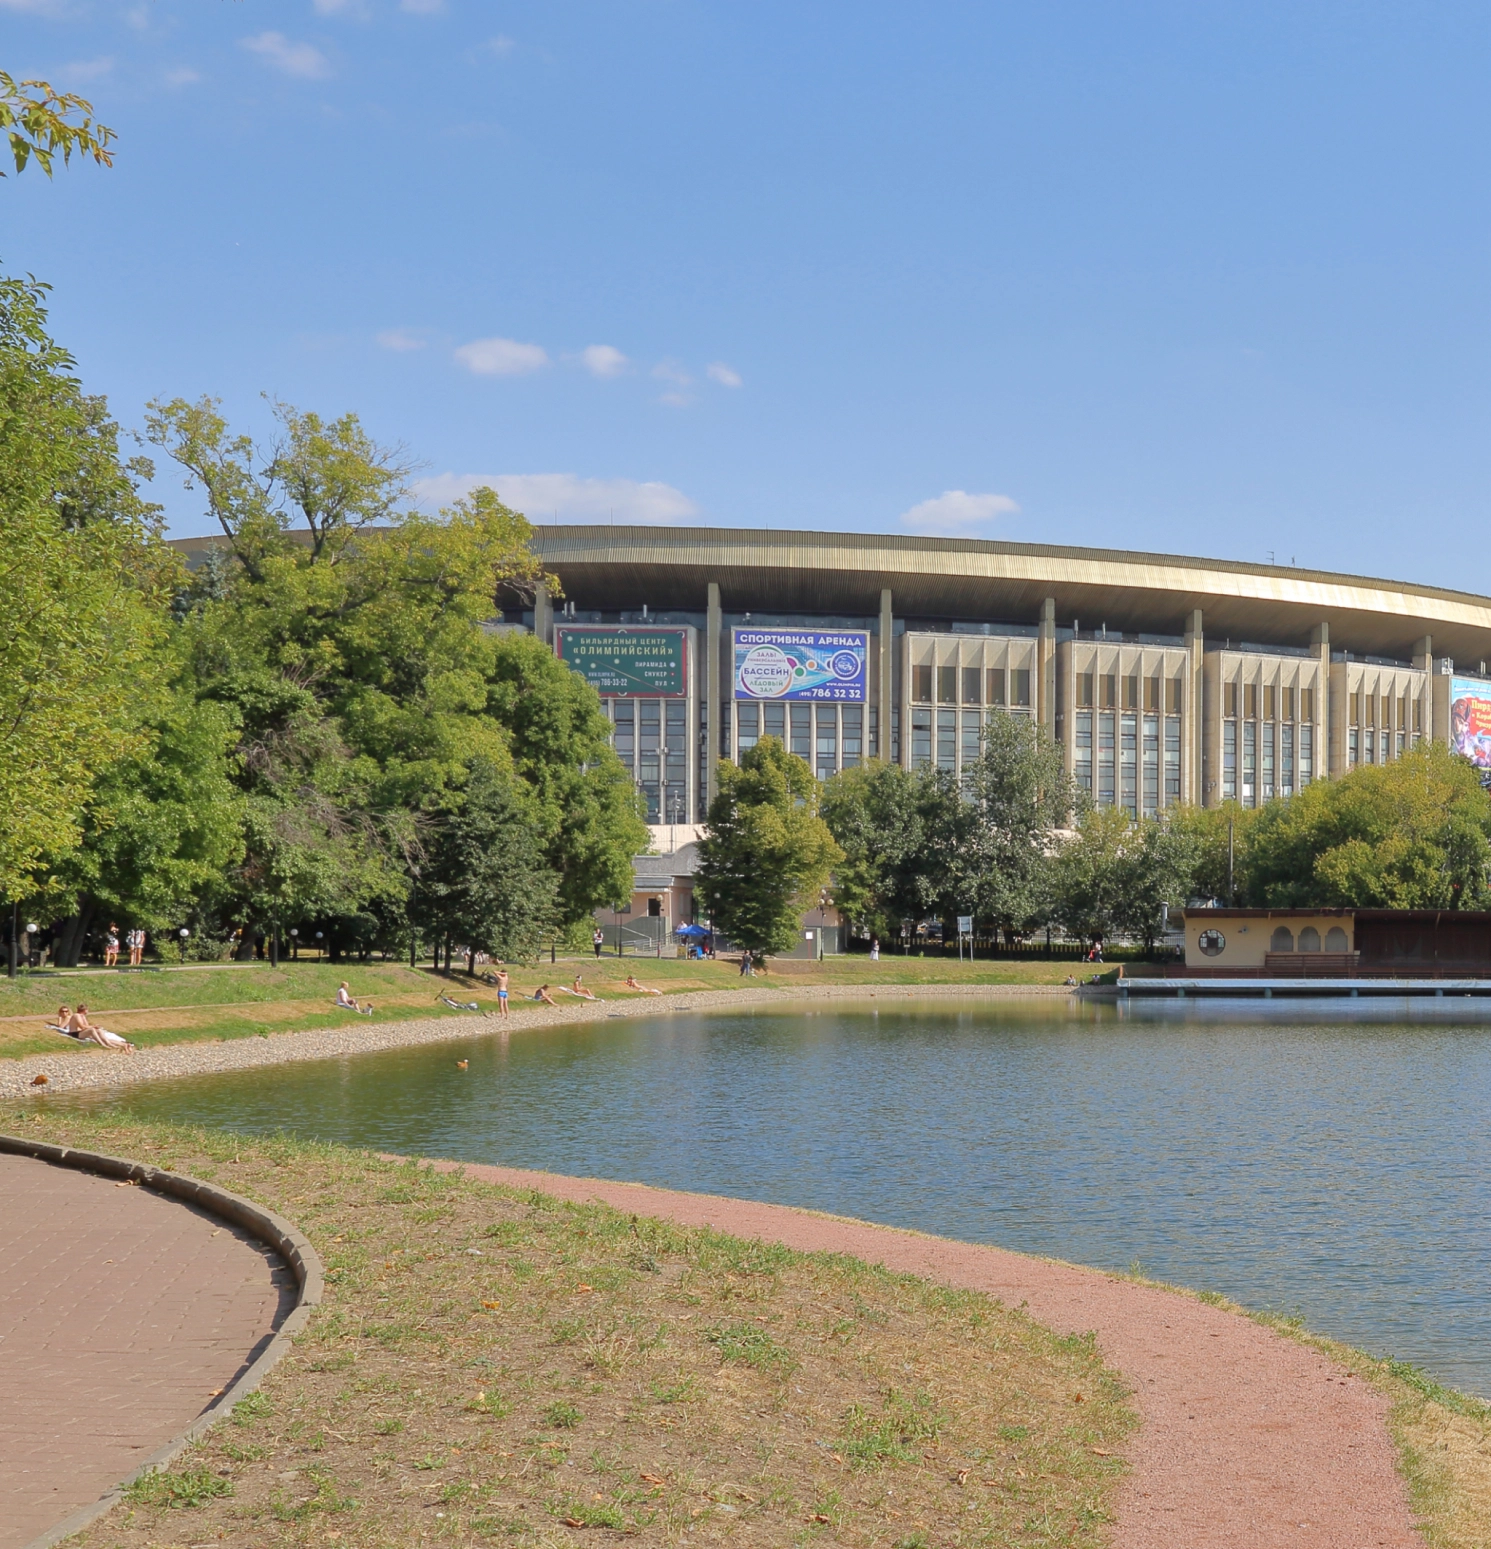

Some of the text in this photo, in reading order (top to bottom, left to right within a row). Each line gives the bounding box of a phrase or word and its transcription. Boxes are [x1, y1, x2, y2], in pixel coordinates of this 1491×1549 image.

[580, 637, 637, 645] БИЛЬЯРДНЫЙ
[740, 634, 861, 646] СПОРТИВНАЯ АРЕНДА
[573, 645, 673, 655] «ОЛИМПИЙСКИЙ»
[744, 666, 789, 676] БАССЕЙН
[749, 679, 783, 687] ЛЕДОВЫЙ
[812, 689, 831, 698] 786
[833, 689, 847, 698] 32
[848, 689, 861, 699] 32
